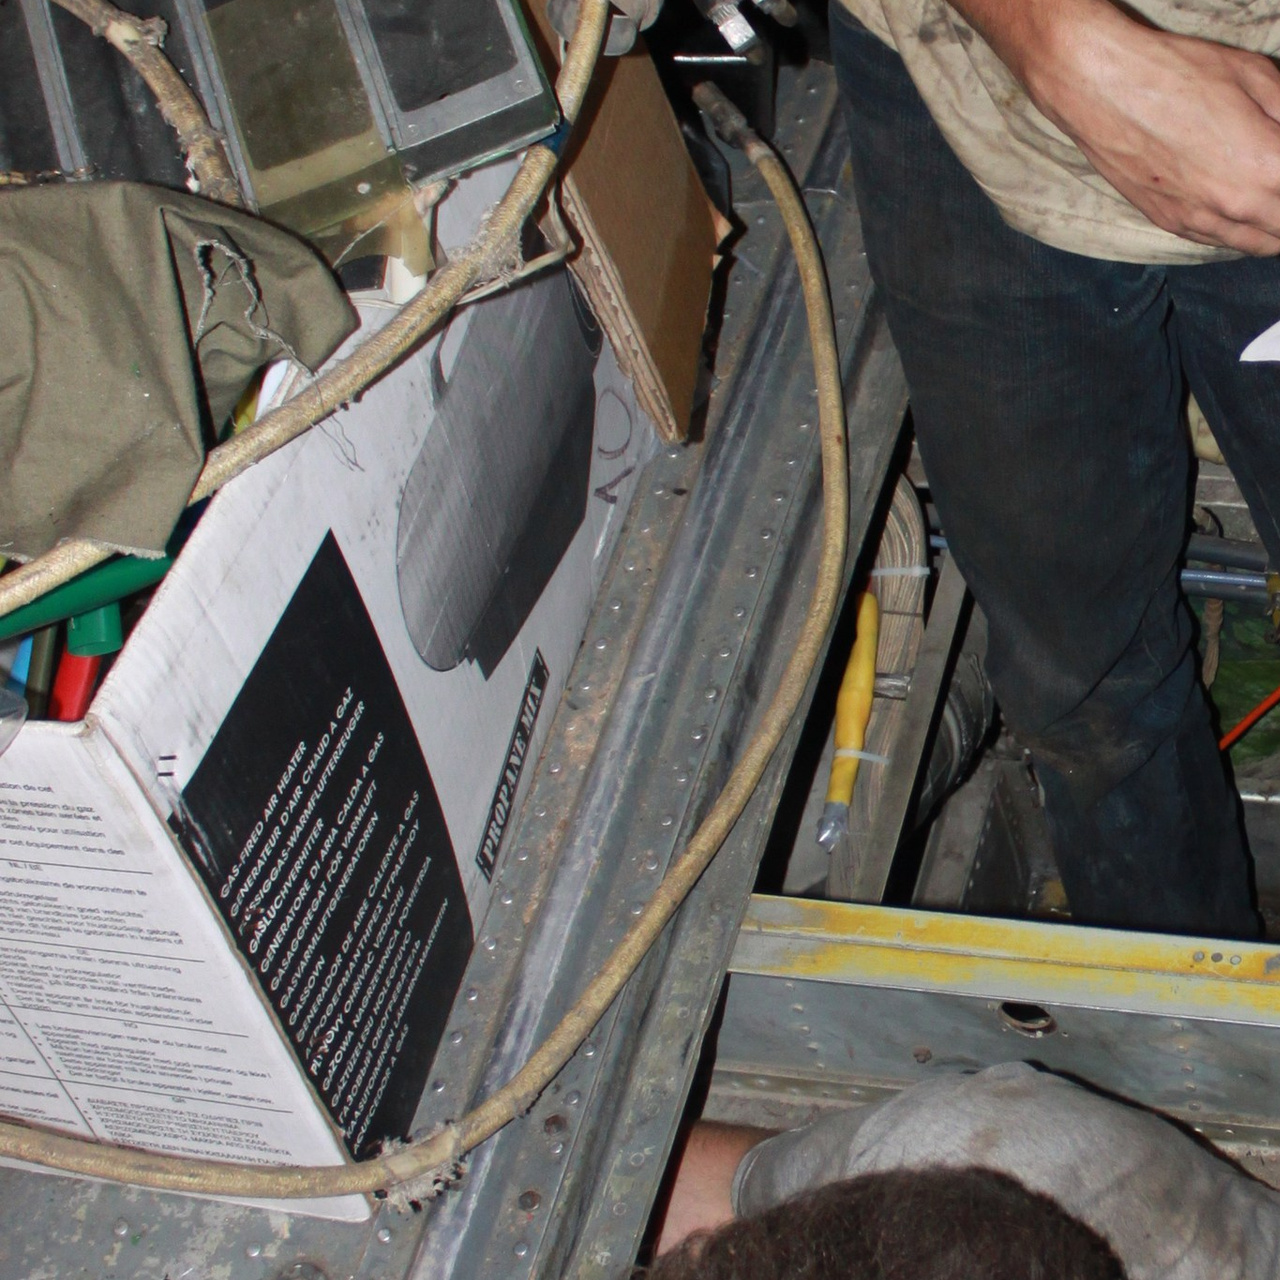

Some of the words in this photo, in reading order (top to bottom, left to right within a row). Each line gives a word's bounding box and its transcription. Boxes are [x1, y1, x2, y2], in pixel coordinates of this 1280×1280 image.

[220, 821, 264, 898] GAS-FIRED
[264, 794, 279, 822] AIR
[277, 741, 306, 794] HEATER
[230, 826, 281, 917] GENERATEUR
[280, 785, 303, 826] D'AIR
[302, 733, 330, 784] CHAUD
[330, 721, 337, 735] A
[336, 687, 353, 719] GAZ
[260, 879, 311, 973] GENERATORE
[309, 860, 320, 880] DI
[320, 827, 338, 862] ARIA
[337, 778, 363, 825] CALDA
[362, 765, 369, 778] A
[368, 732, 384, 763] GAS
[483, 732, 526, 864] PROPANE
[521, 678, 541, 734] MIX
[249, 818, 324, 954] GASLUCHVERHITTER
[270, 881, 327, 991] GASAGGREGAT
[326, 850, 343, 882] FÖR
[341, 780, 376, 848] VARMLUFT
[280, 811, 378, 1008] GASVARMLUFTGENERATOREN
[296, 954, 342, 1042] GENERADOR
[342, 931, 353, 953] DE
[353, 898, 369, 932] AIRE
[368, 835, 399, 898] CALIENTE
[399, 824, 405, 835] A
[404, 791, 419, 820] GAS
[373, 886, 404, 948] VZDUCHU
[289, 955, 325, 1025] GASSOVN
[322, 1030, 354, 1091] GAZOWA
[352, 929, 400, 1028] NAGRZEWNICA
[398, 856, 431, 927] POWIETRZA
[339, 1050, 373, 1124] ГАЗОВЫЙ
[344, 1029, 394, 1139] KAASUTOIMINEN
[354, 1067, 391, 1154] AQUECEDOR
[391, 1056, 396, 1067] A
